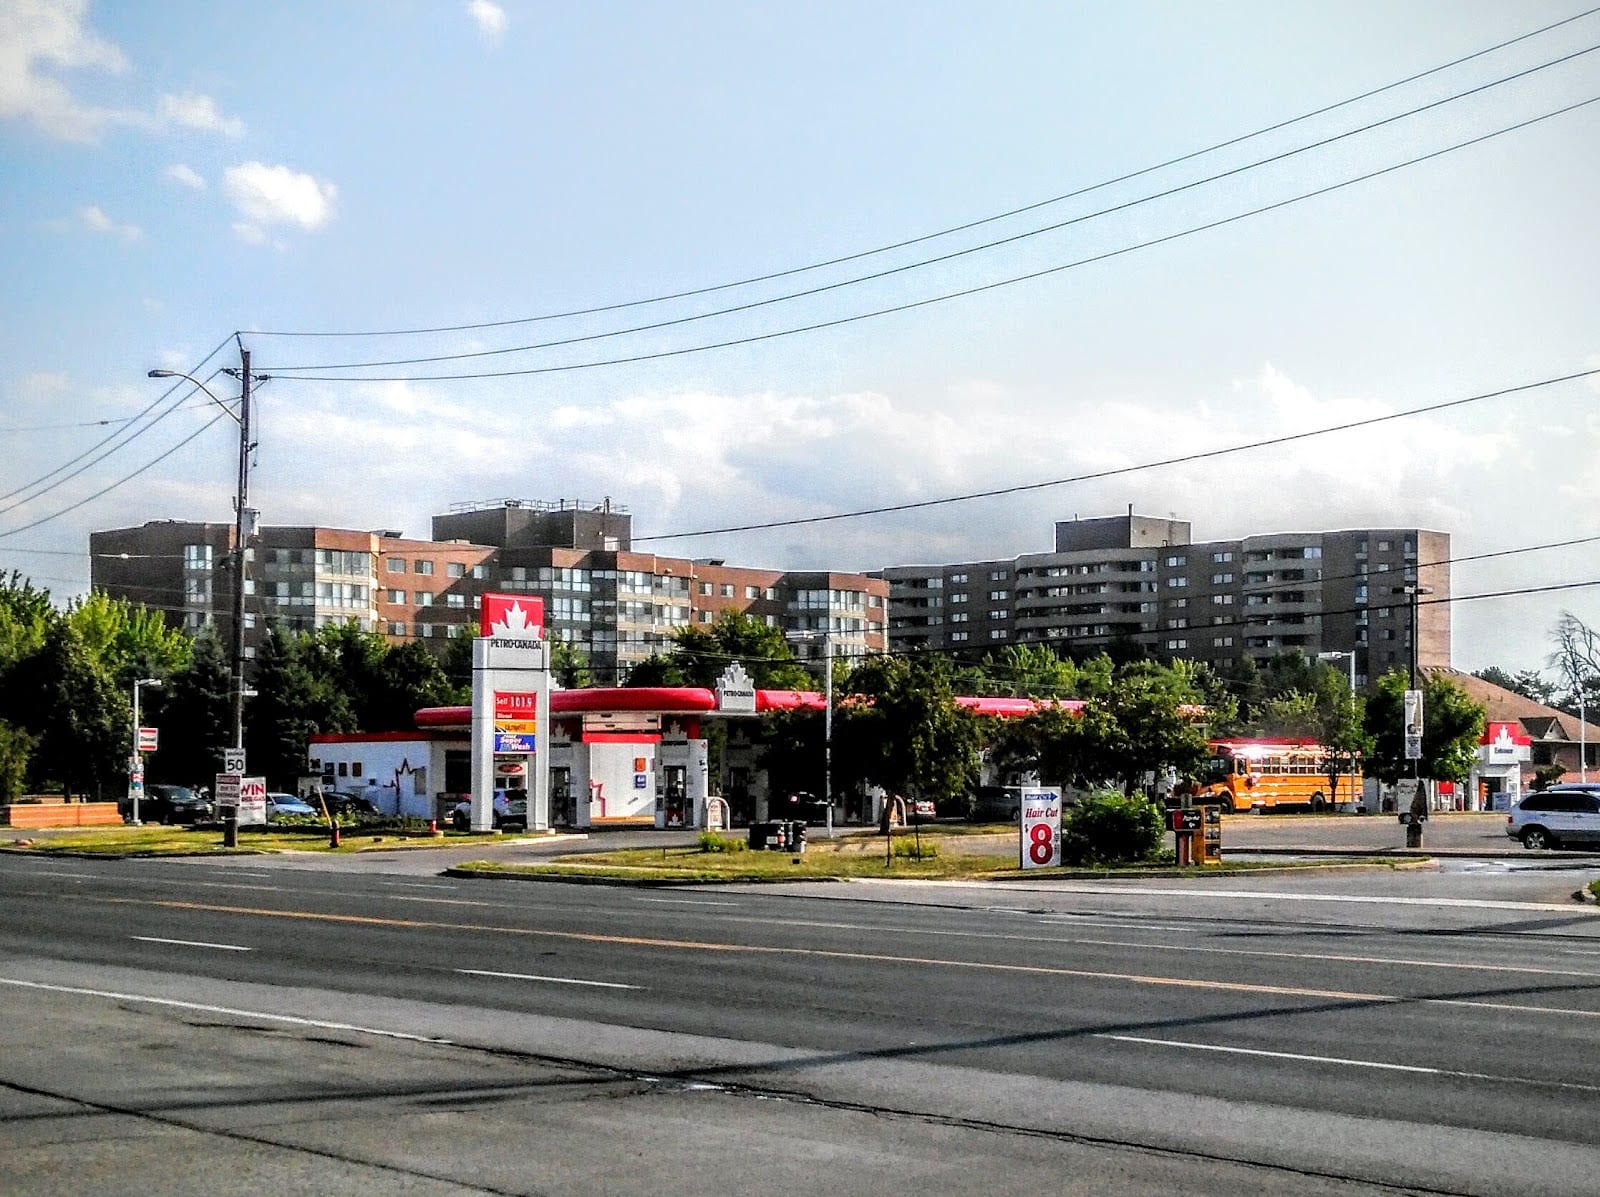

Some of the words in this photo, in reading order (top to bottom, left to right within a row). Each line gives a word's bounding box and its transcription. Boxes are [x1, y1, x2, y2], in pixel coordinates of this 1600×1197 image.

[490, 639, 542, 650] PETRO-CANADA
[511, 742, 531, 750] Wash
[227, 759, 244, 771] 50
[241, 783, 265, 796] WIN
[1025, 808, 1045, 818] Hair
[1046, 807, 1059, 818] Cut
[1029, 823, 1053, 865] 8
